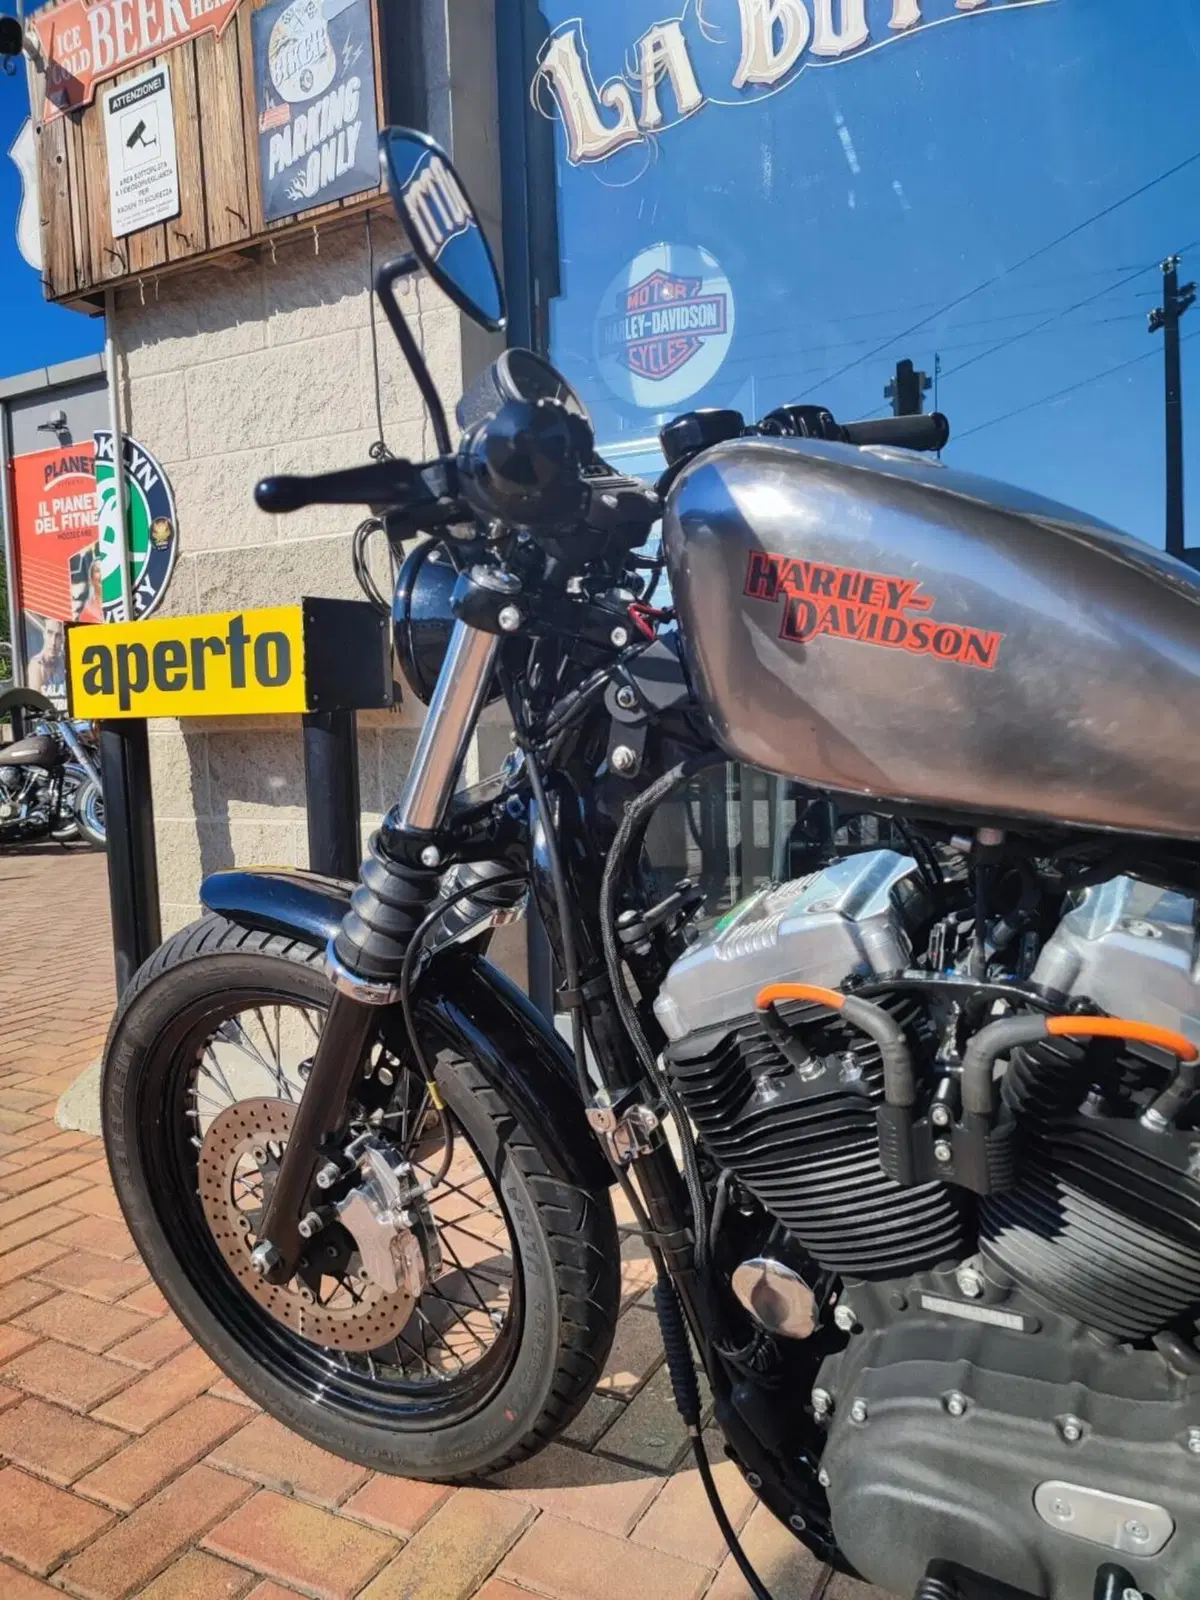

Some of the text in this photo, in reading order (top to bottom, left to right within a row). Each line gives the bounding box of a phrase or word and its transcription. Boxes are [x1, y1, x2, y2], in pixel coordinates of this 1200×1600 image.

[52, 47, 91, 85] COLD
[55, 25, 81, 56] ICE
[86, 0, 190, 75] BEER
[273, 26, 327, 88] BIKER
[112, 77, 162, 111] ATTENZIONE!
[540, 21, 703, 163] LA
[268, 75, 362, 181] PARKING
[305, 120, 362, 198] ONLY
[627, 275, 687, 312] MOTOR
[628, 336, 690, 374] CYCLES
[35, 516, 60, 535] DEL
[38, 500, 50, 517] IL
[743, 551, 936, 613] HARLEY-
[82, 614, 292, 711] aperto
[778, 596, 1005, 671] DAVIDSON
